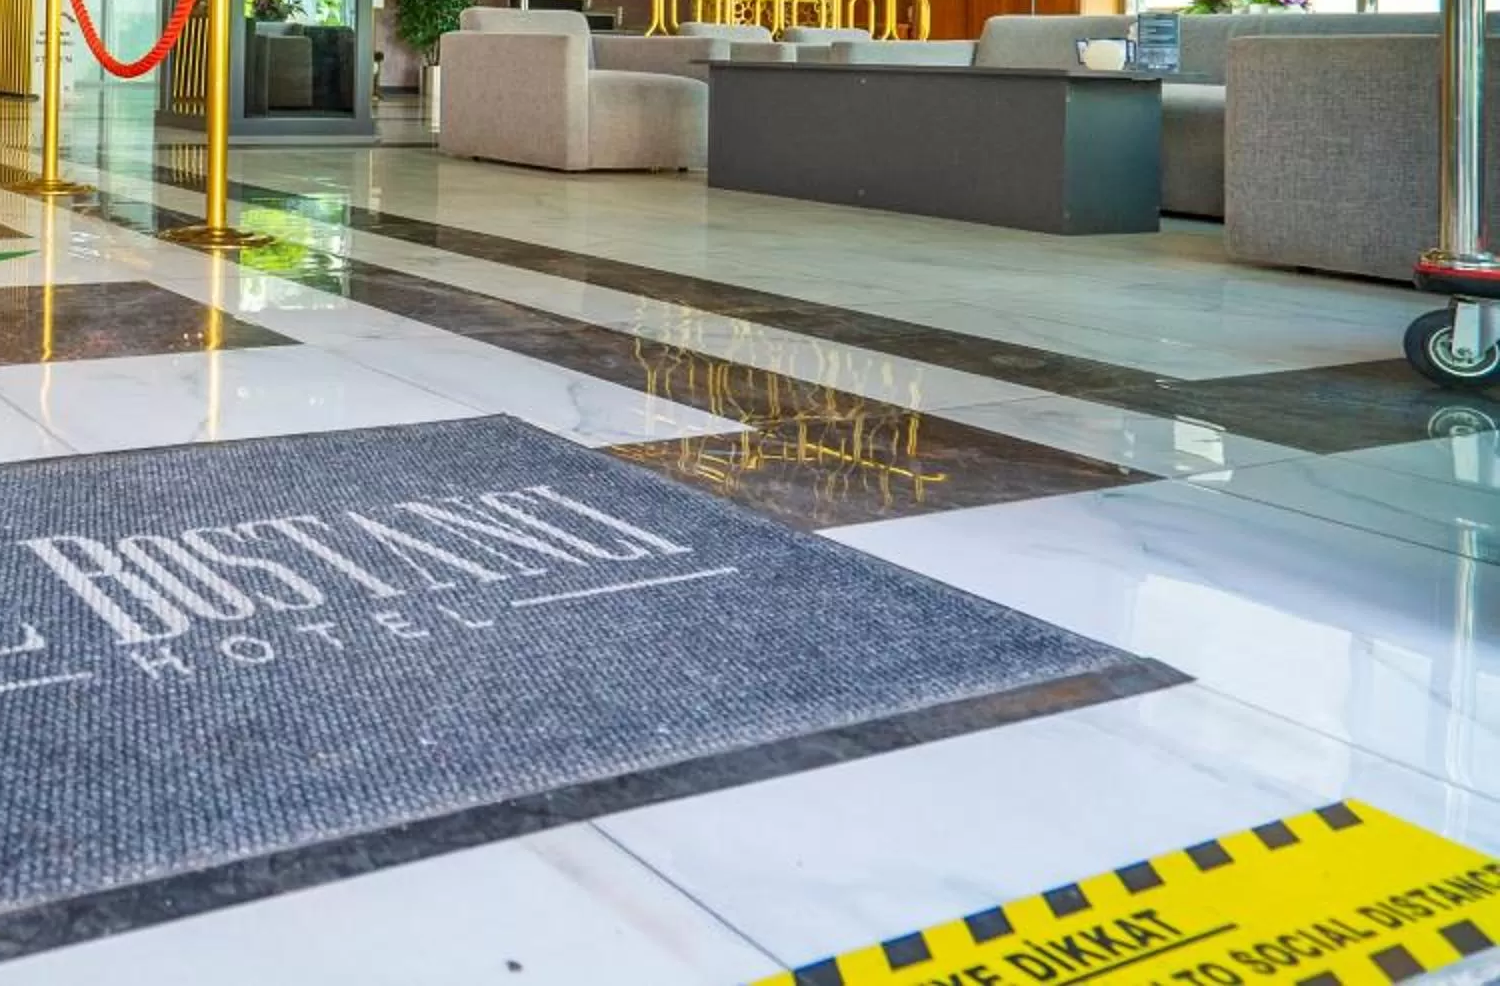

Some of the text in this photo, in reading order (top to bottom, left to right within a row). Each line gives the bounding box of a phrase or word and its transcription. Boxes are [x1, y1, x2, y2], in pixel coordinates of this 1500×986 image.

[17, 485, 693, 646] BOSTANCI
[130, 604, 497, 680] HOTEL
[1002, 908, 1185, 982] DİKKAT
[1172, 963, 1244, 986] TO
[1228, 918, 1378, 975] SOCIAL
